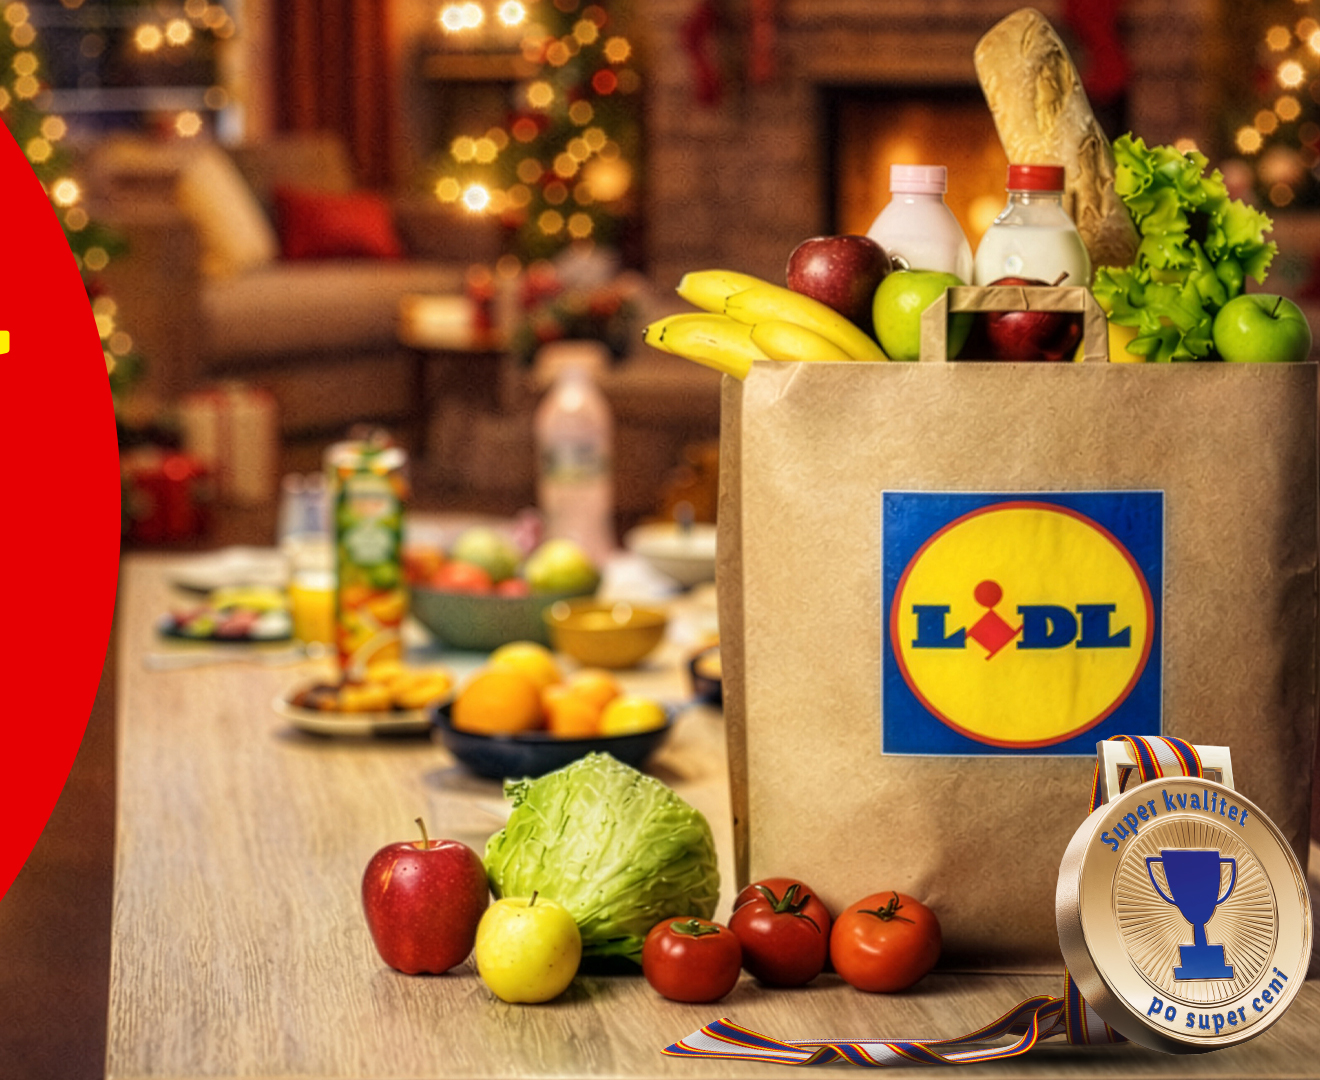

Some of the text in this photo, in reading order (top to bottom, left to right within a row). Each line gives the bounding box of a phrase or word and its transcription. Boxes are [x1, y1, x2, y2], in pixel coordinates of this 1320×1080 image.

[1100, 789, 1249, 852] Super kvalitet
[1146, 966, 1289, 1035] po super ceni
